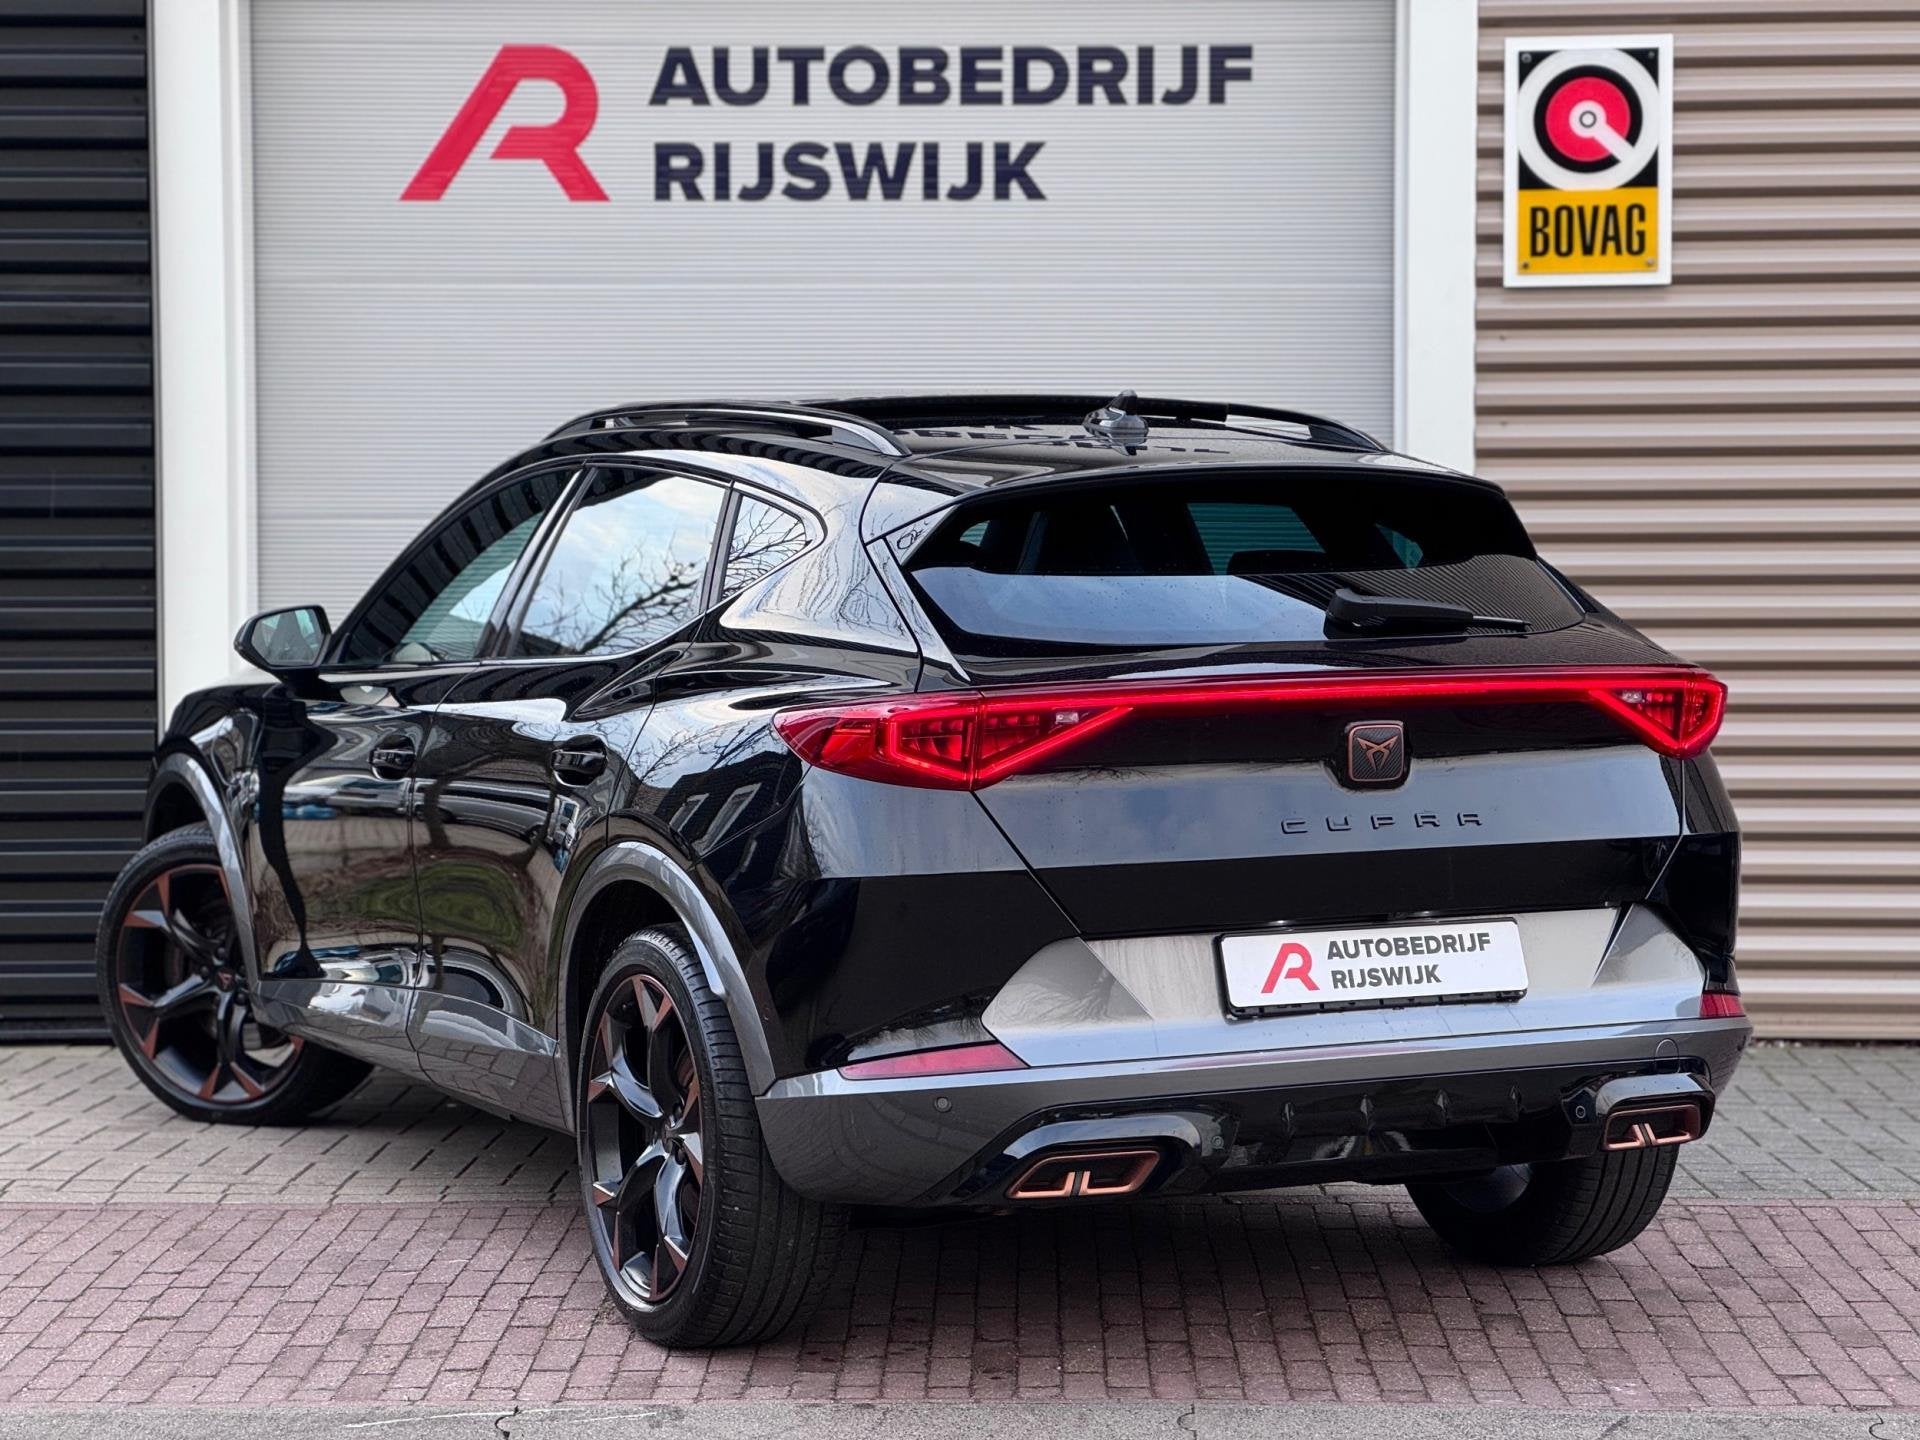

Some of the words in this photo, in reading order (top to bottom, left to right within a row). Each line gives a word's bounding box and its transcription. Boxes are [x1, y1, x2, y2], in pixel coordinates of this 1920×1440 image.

[649, 46, 1255, 105] AUTOBEDRIJF
[654, 142, 1048, 202] RIJSWIJK
[1530, 204, 1646, 257] BOVAG
[1281, 812, 1484, 834] CUPRA
[1327, 933, 1491, 960] AUTOBEDRIJF
[1331, 965, 1441, 989] RIJSWIJK
